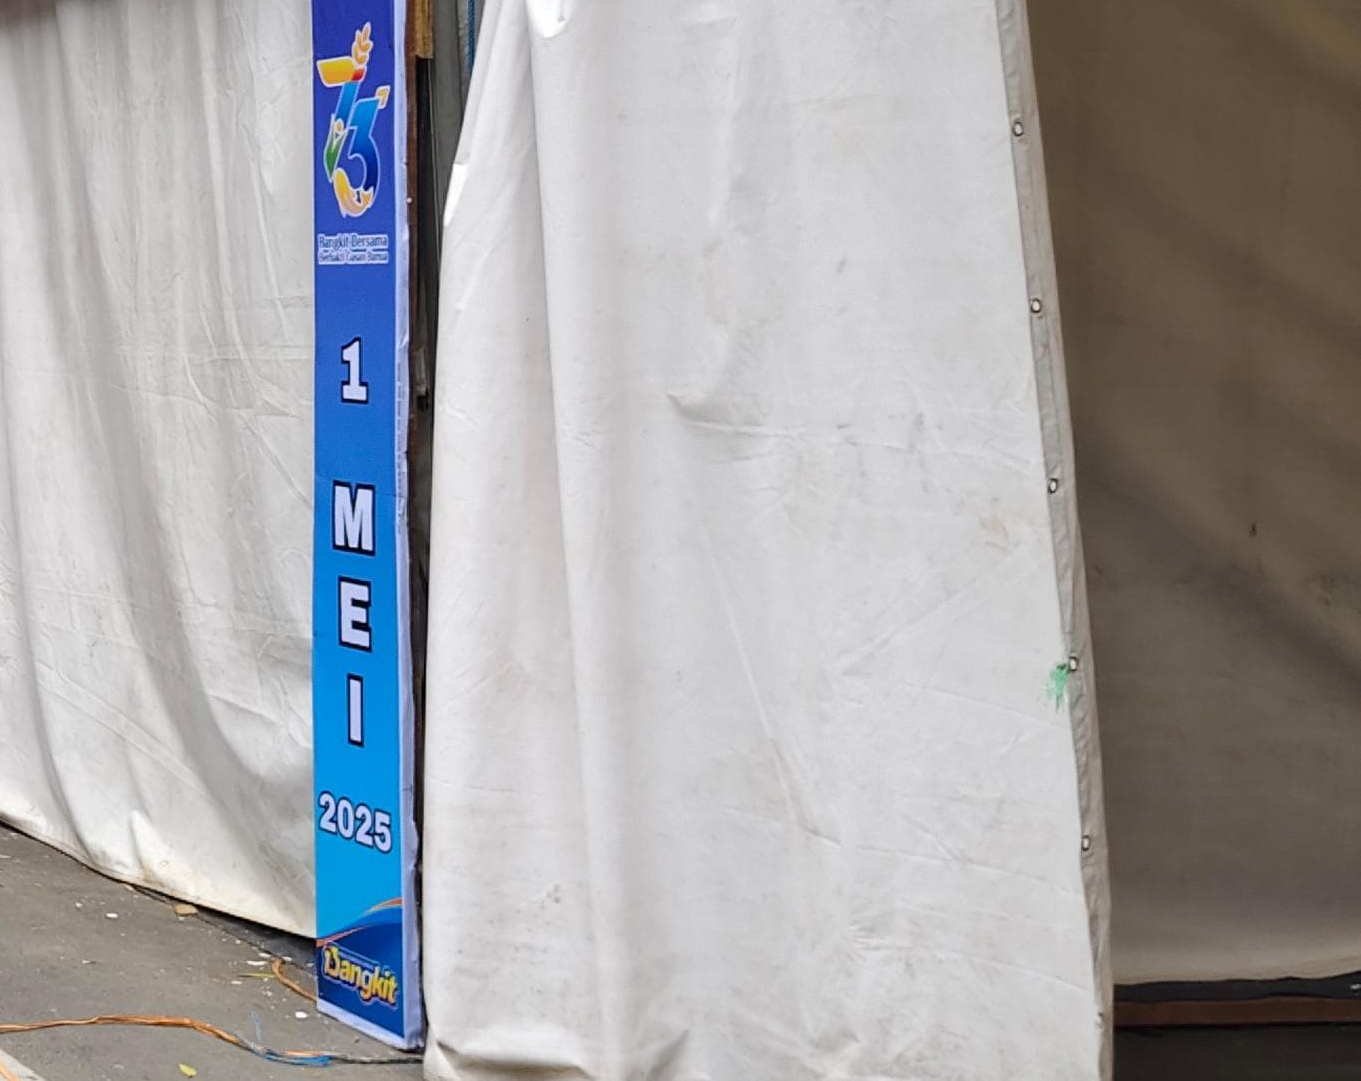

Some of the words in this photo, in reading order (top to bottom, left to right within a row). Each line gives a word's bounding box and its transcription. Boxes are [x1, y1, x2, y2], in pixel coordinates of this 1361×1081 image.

[341, 336, 369, 403] 1
[332, 480, 376, 748] MEI
[318, 790, 393, 854] 2025
